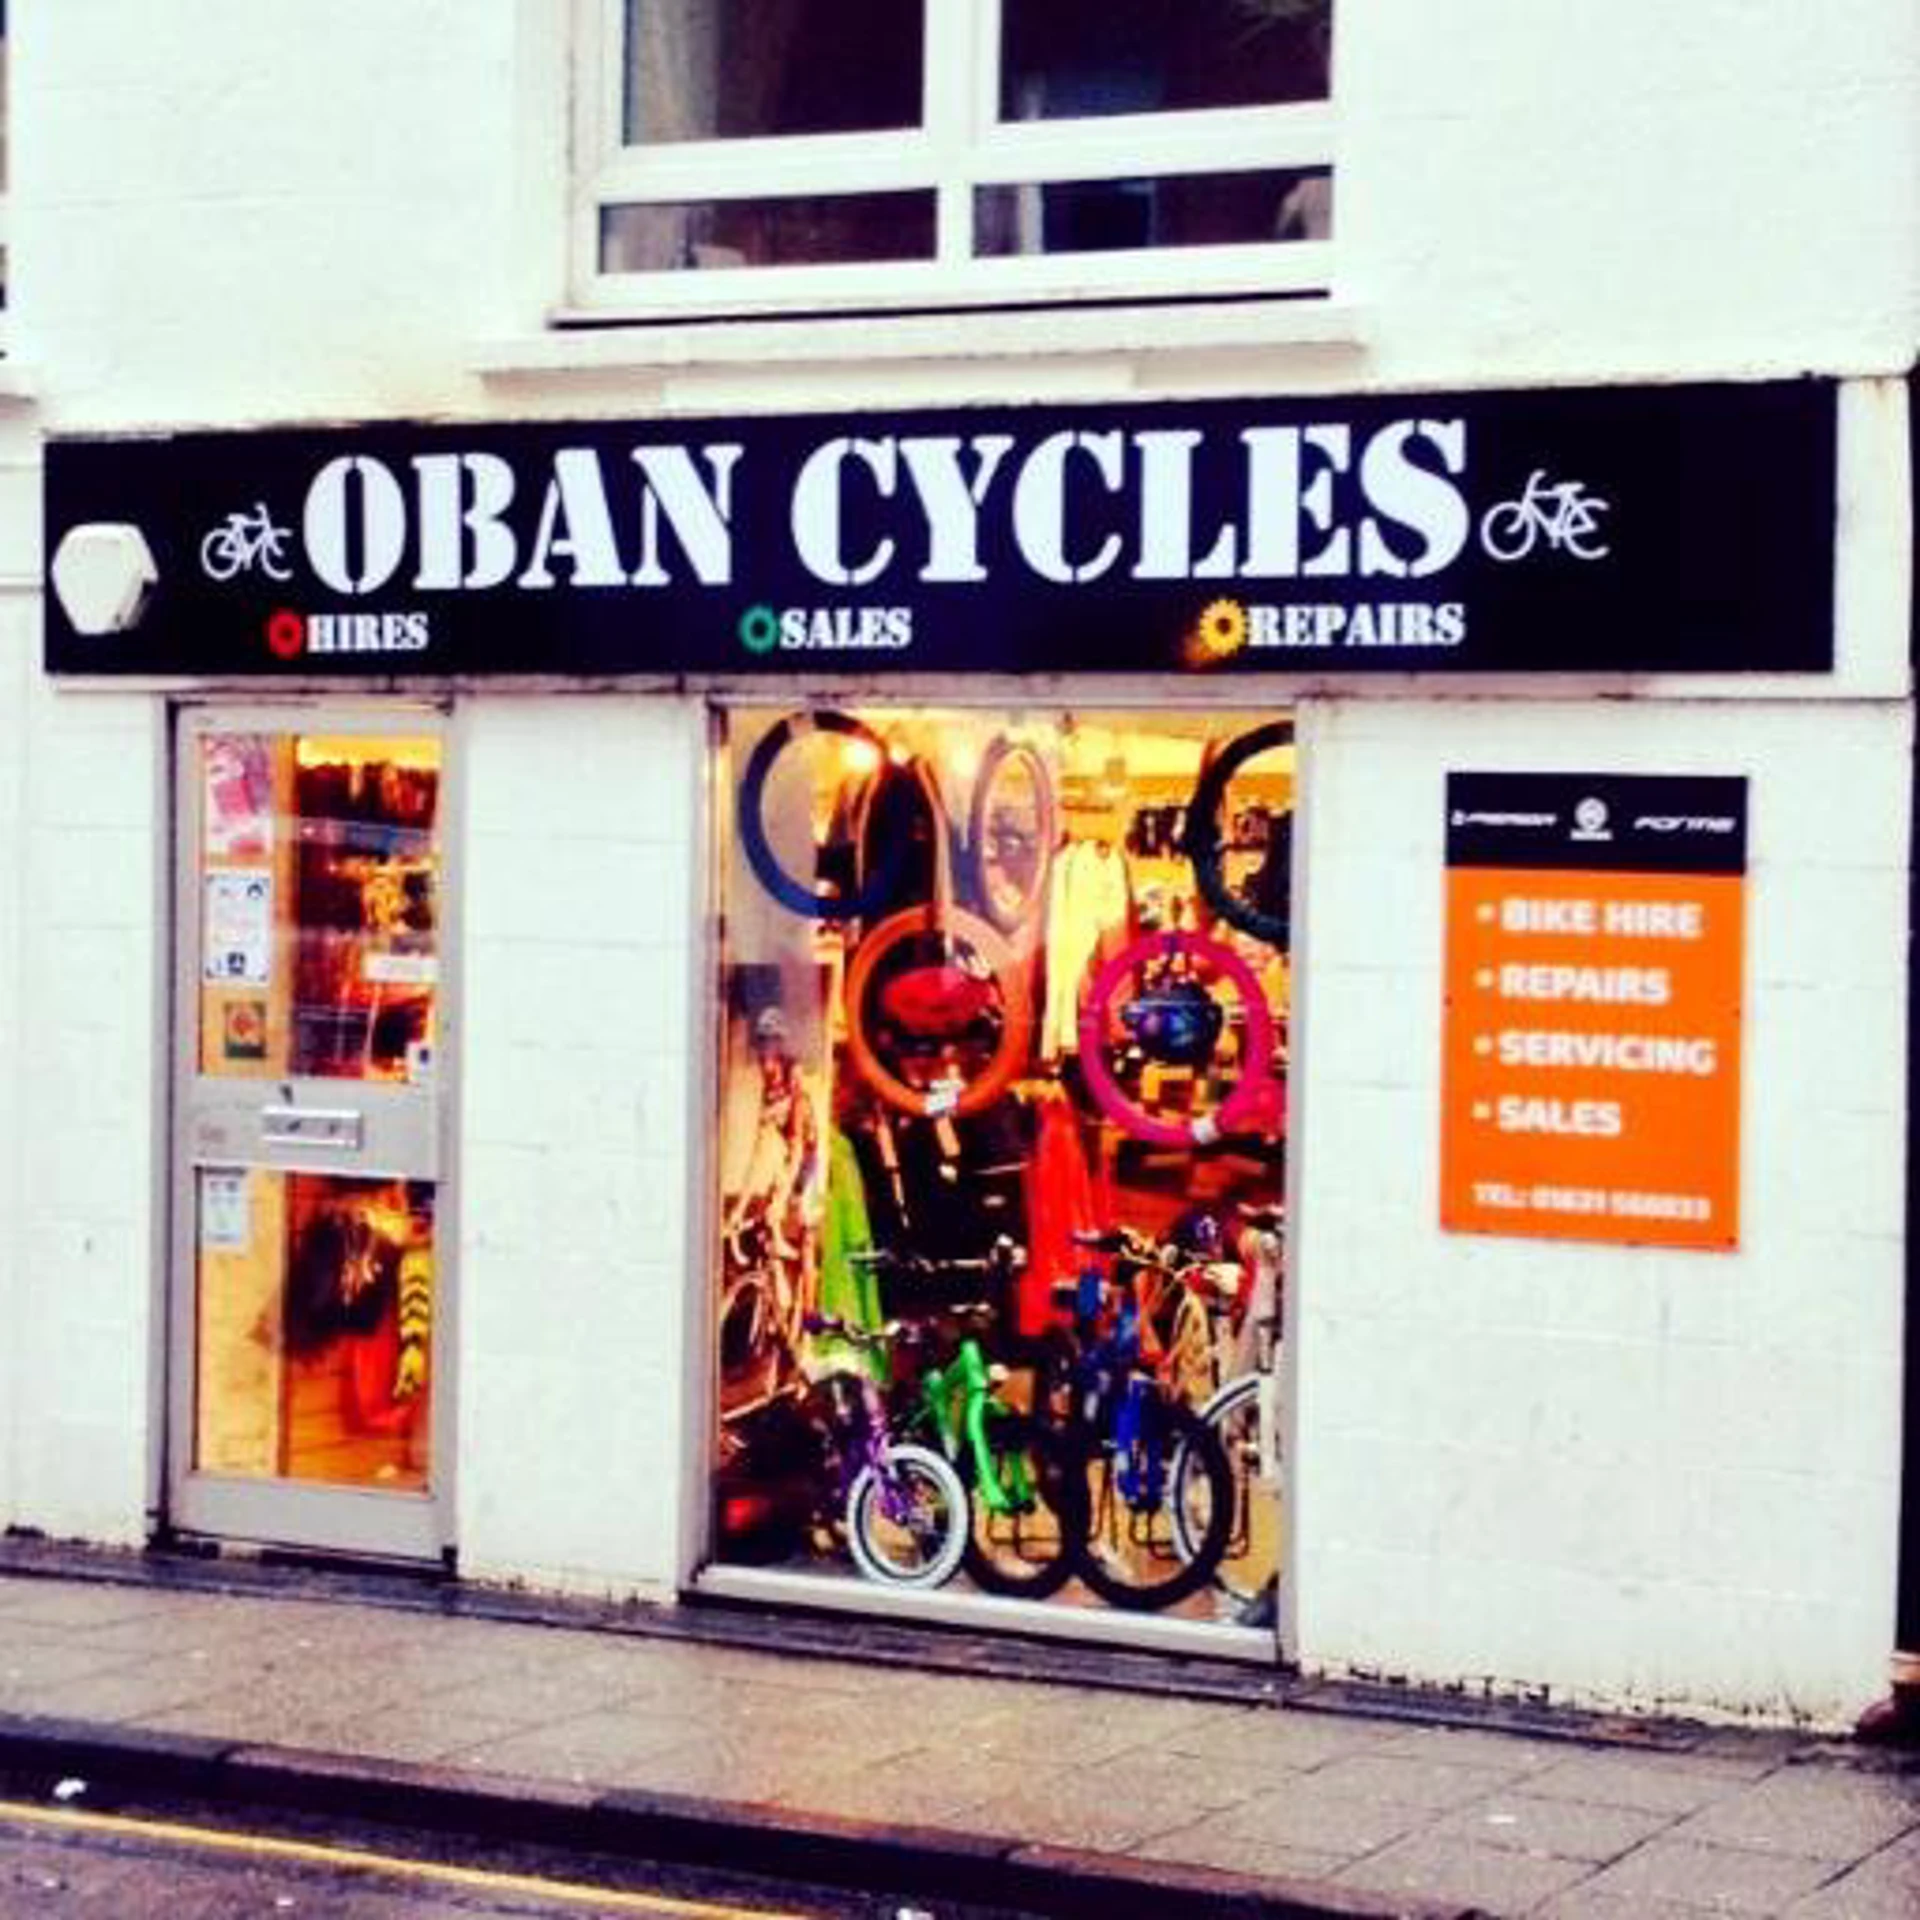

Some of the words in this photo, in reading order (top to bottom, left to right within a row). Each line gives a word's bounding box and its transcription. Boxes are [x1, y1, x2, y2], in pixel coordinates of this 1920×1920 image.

[303, 444, 744, 594] OBAN
[790, 418, 1469, 584] CYCLES
[306, 612, 429, 653] HIRES
[780, 607, 912, 650] SALES
[1247, 603, 1465, 647] REPAIRS
[1501, 899, 1598, 934] BIKE
[1604, 902, 1703, 938] HIRE
[1500, 965, 1671, 1003] REPAIRS
[1499, 1032, 1716, 1074] SERVICING
[1499, 1097, 1622, 1135] SALES
